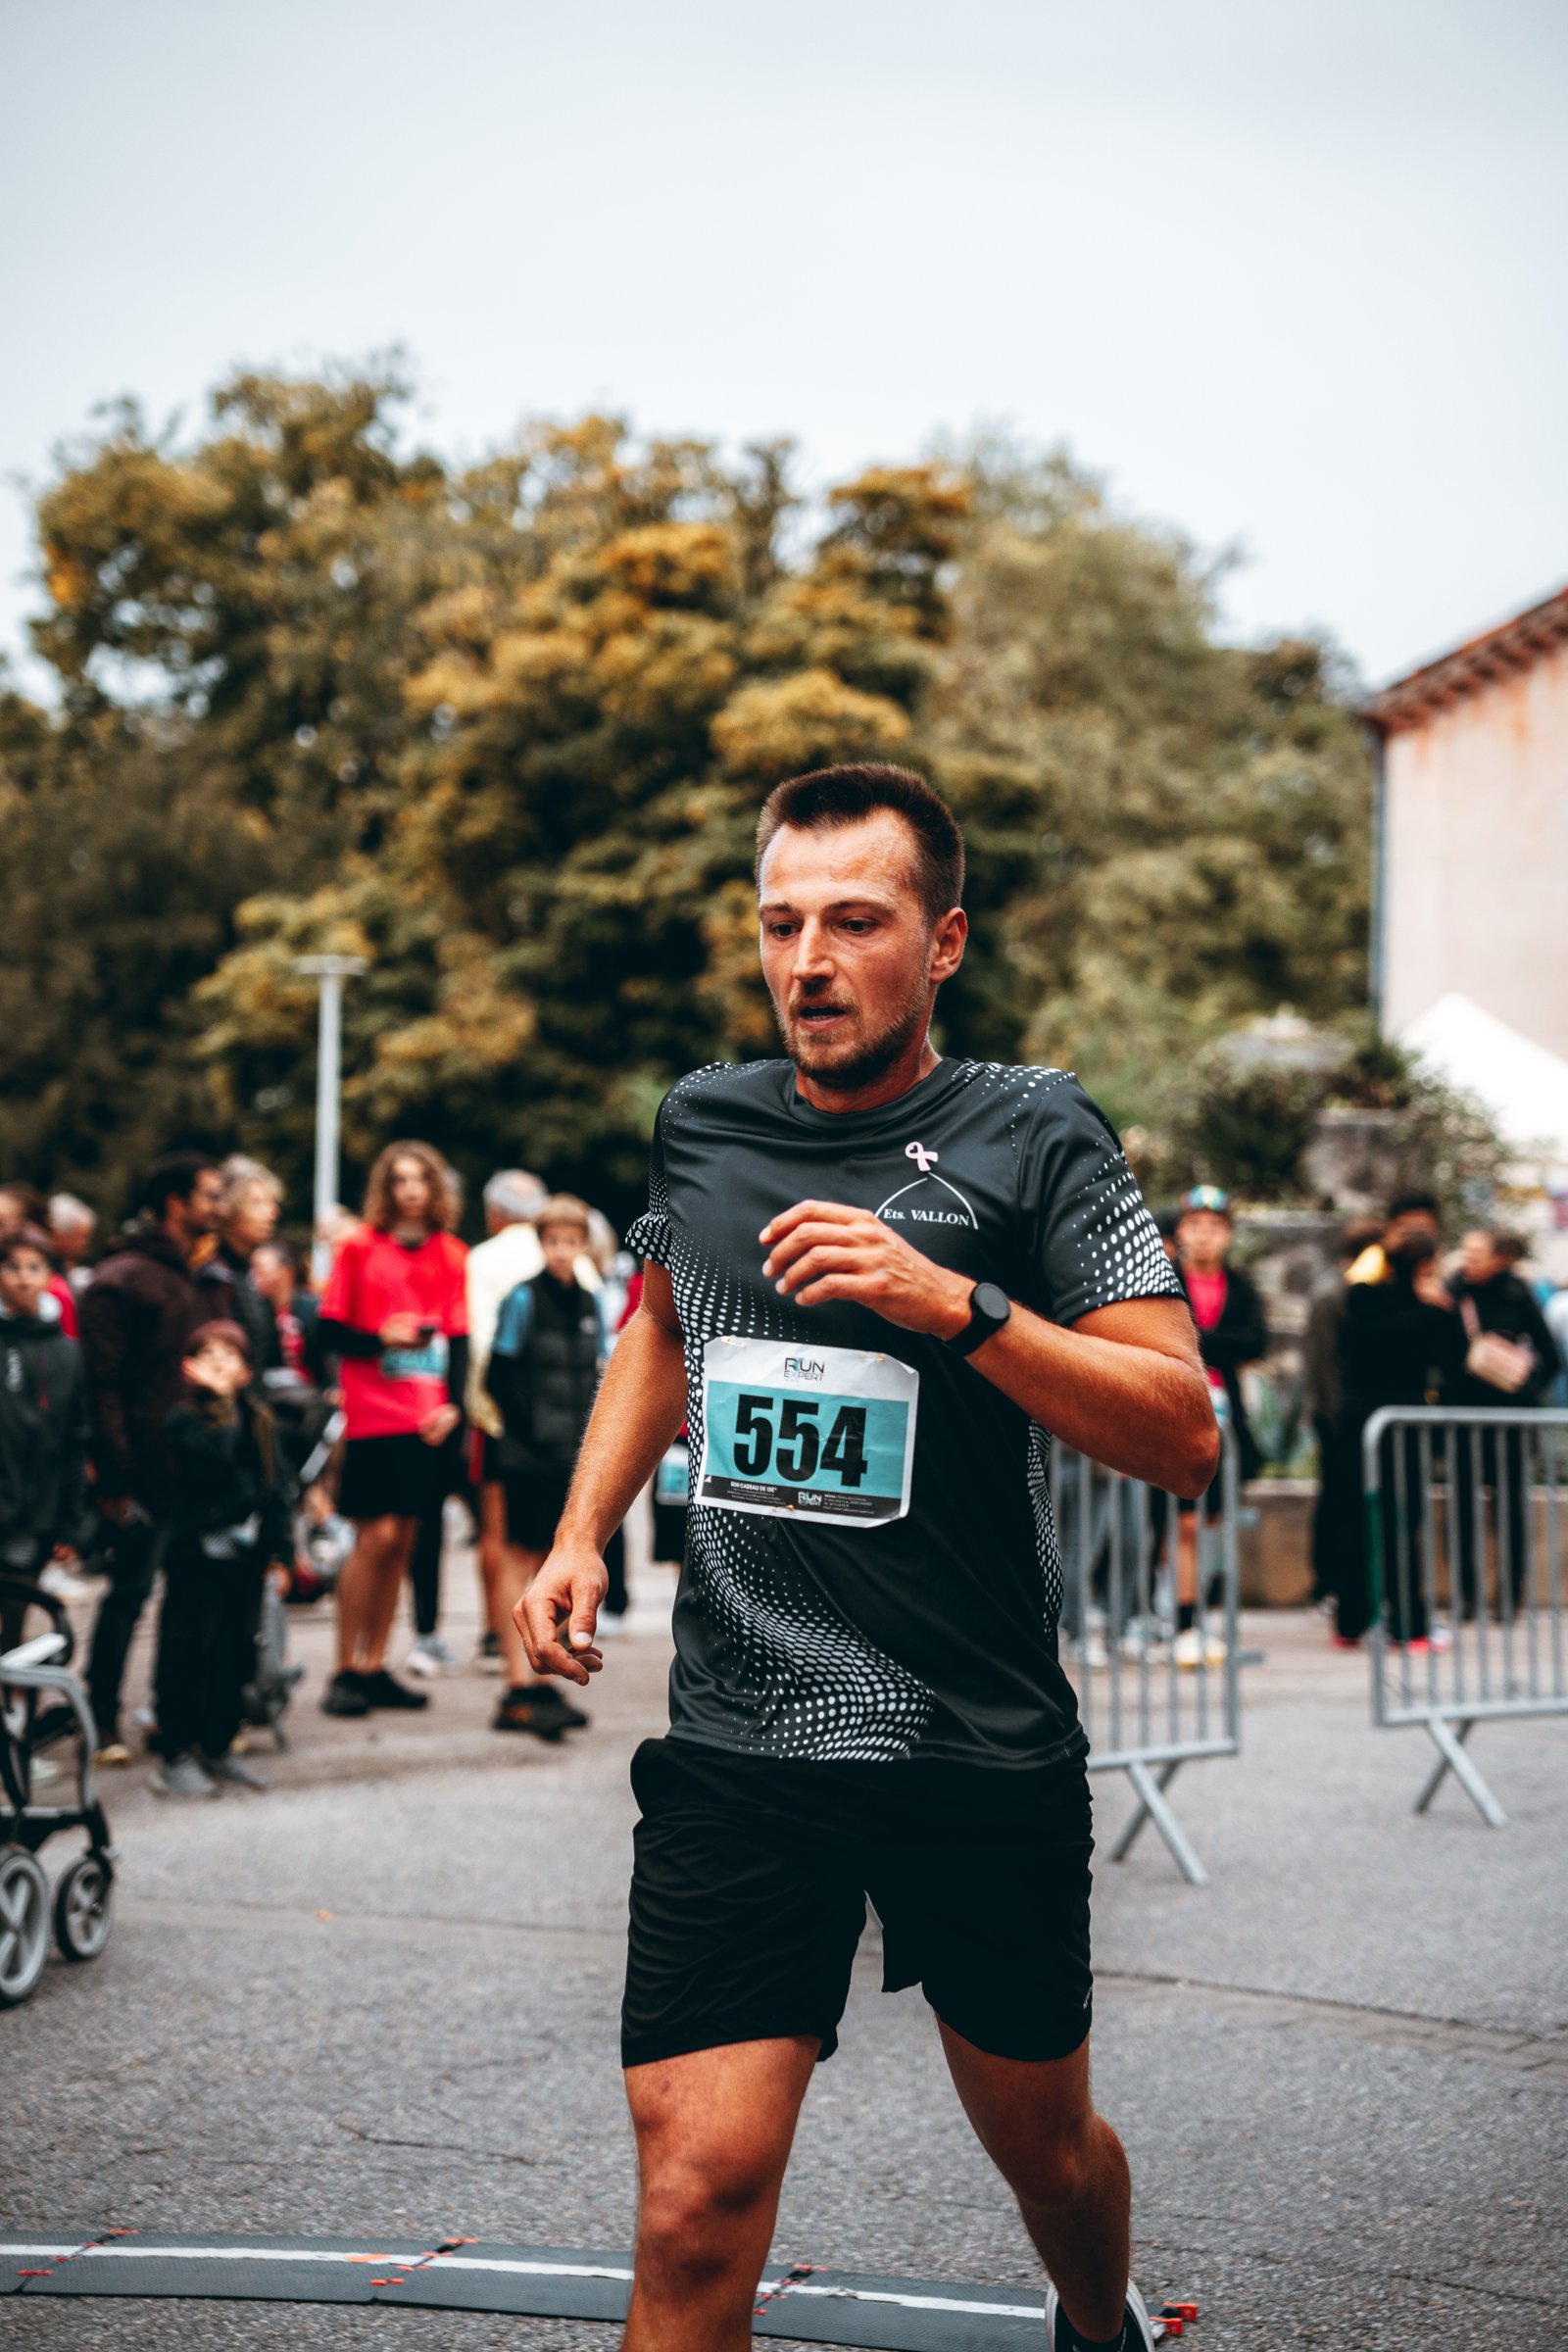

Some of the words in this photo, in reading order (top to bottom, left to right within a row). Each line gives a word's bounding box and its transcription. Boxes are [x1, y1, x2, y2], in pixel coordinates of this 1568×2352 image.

[883, 1208, 906, 1220] Ets.
[910, 1209, 969, 1226] VALLON
[784, 1357, 824, 1374] RUN
[784, 1371, 824, 1382] EXPERT
[733, 1394, 867, 1488] 554
[740, 1482, 760, 1492] CADEAU
[798, 1492, 822, 1502] RUN
